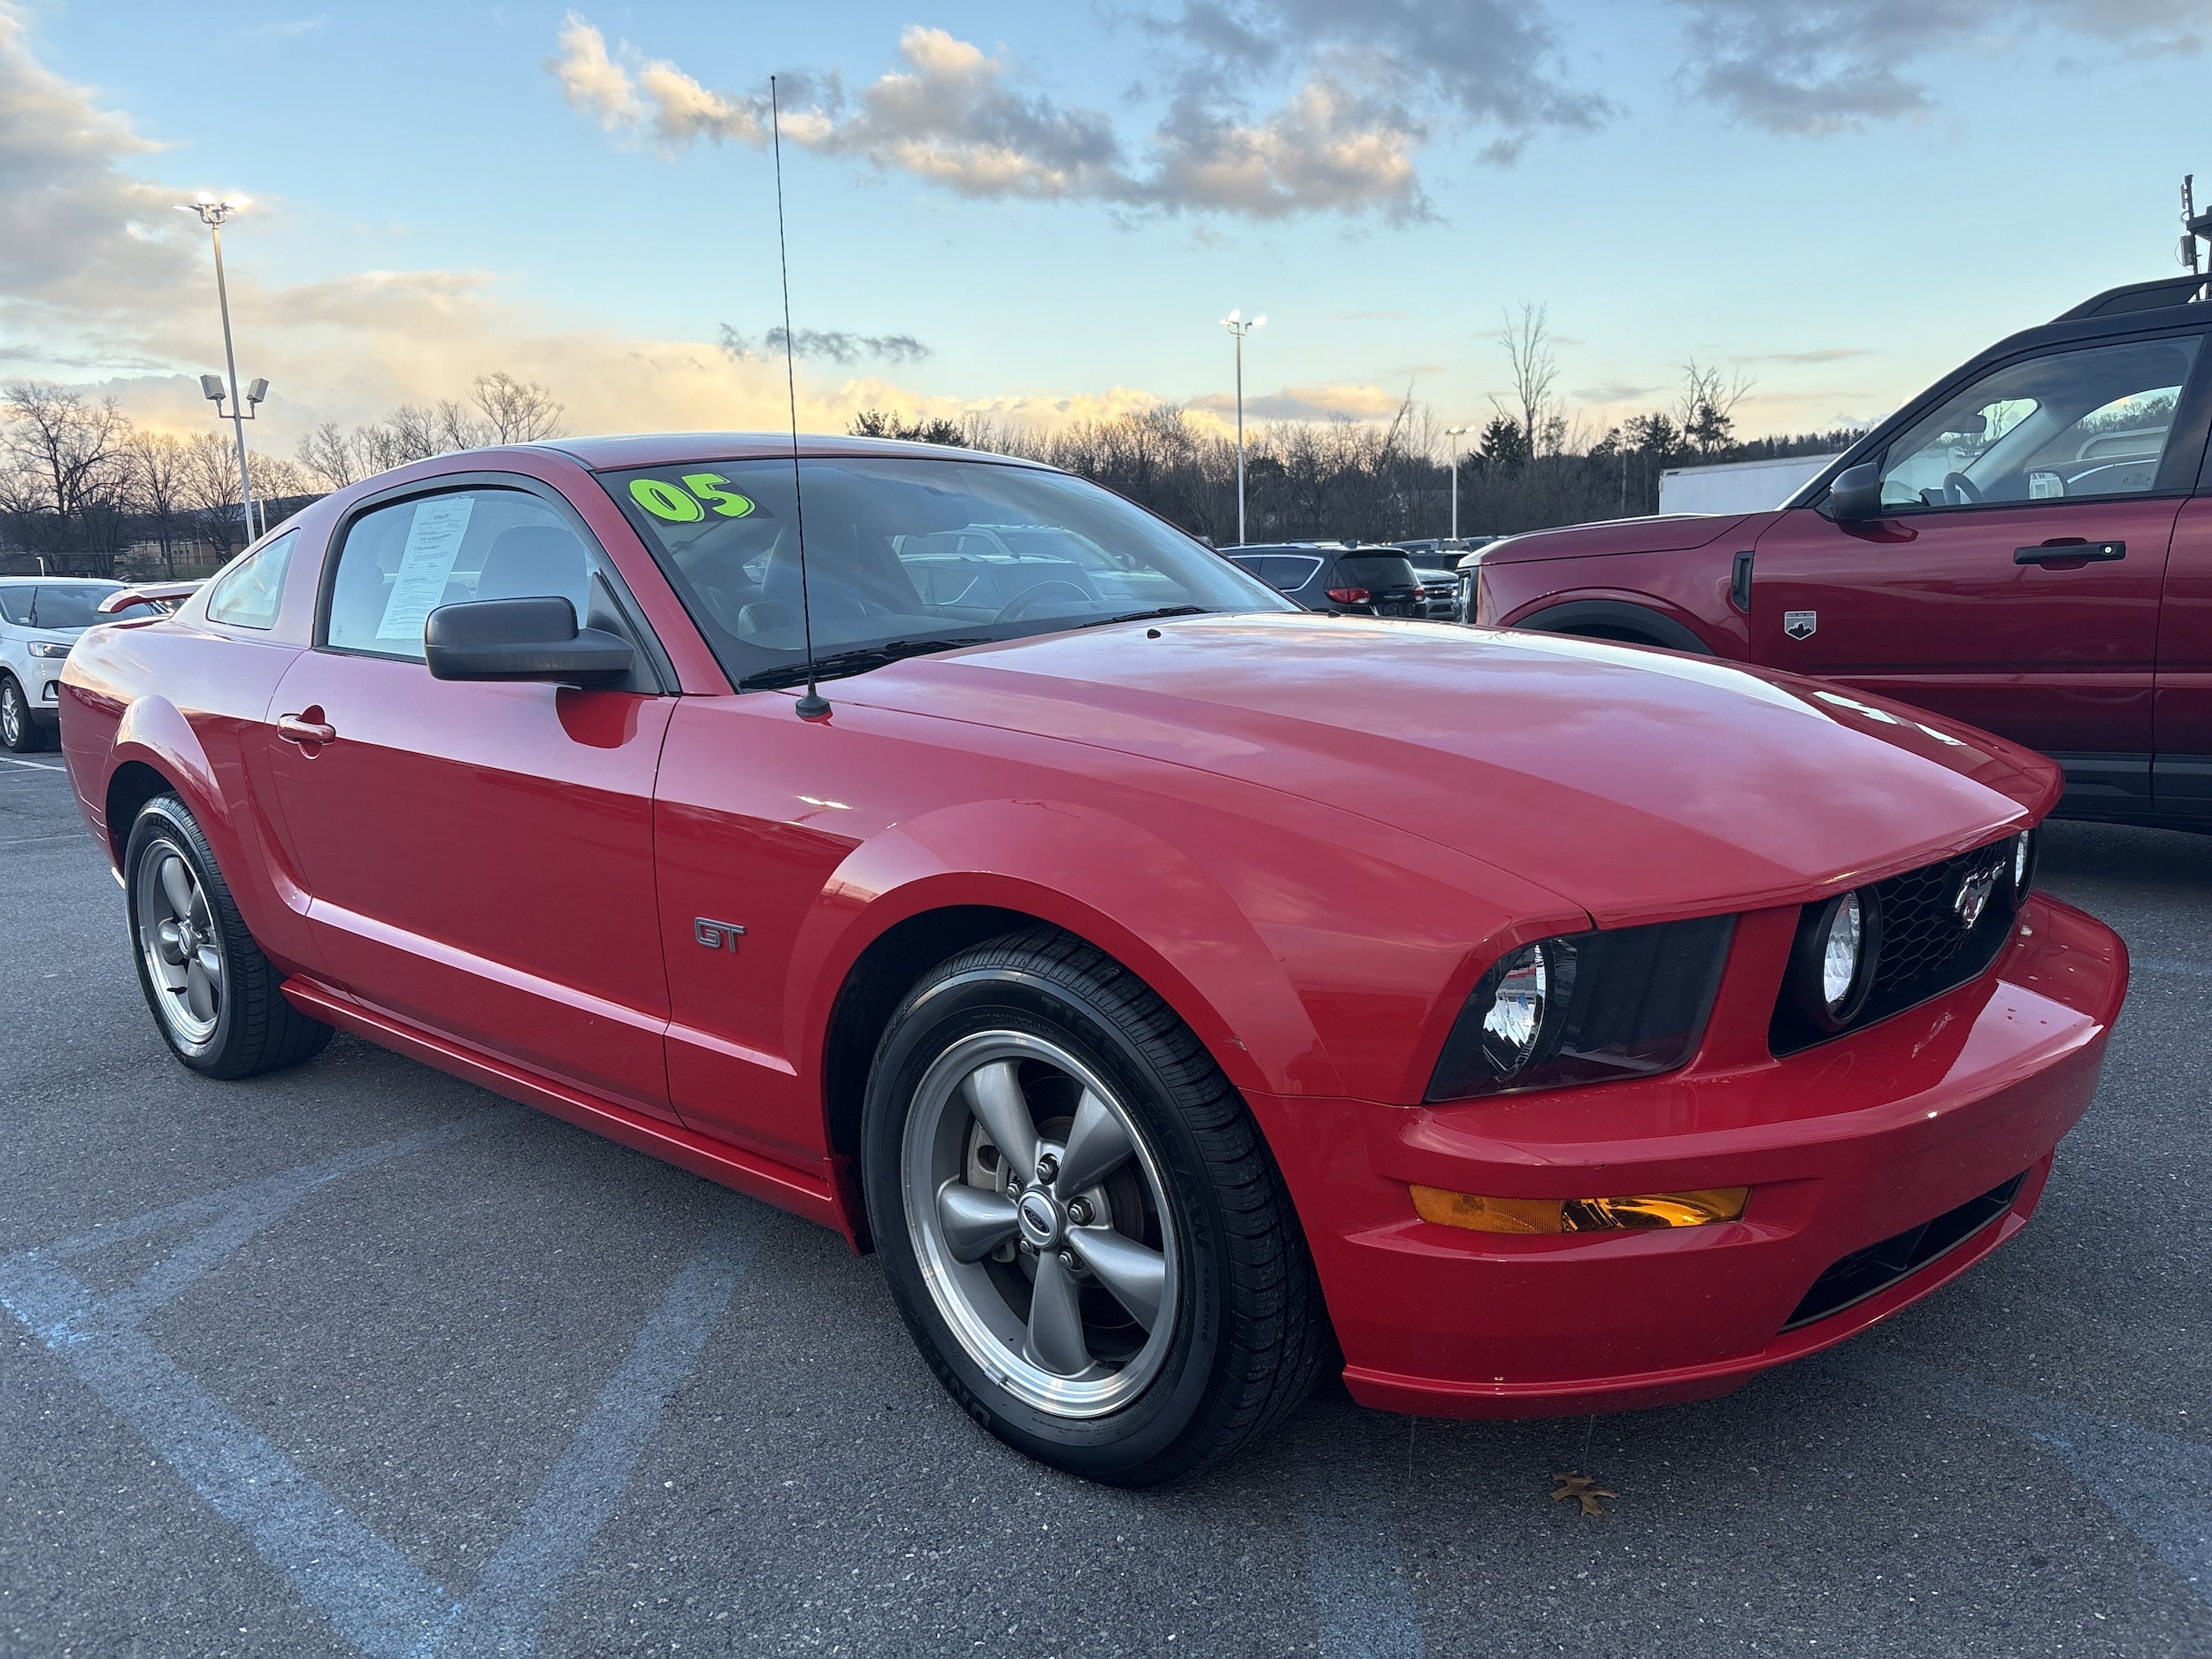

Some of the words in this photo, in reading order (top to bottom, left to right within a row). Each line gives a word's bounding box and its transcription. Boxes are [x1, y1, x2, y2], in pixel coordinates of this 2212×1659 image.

[628, 472, 757, 524] 05
[694, 916, 746, 952] GT
[1041, 995, 1144, 1092] TIGER
[1201, 1265, 1212, 1342] TOURING
